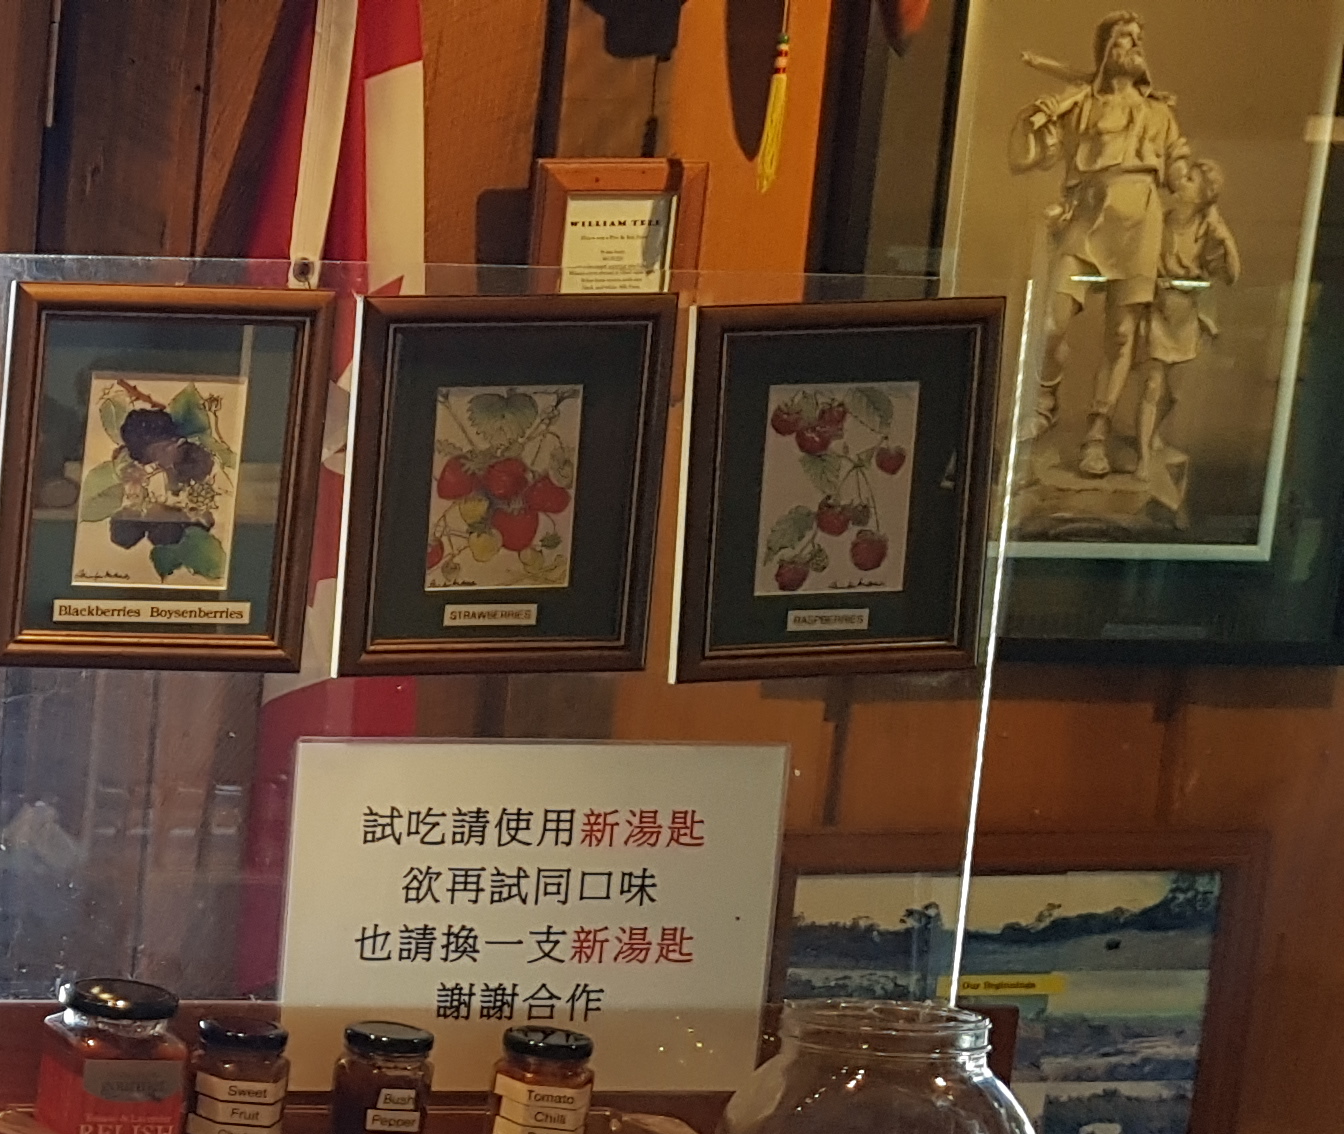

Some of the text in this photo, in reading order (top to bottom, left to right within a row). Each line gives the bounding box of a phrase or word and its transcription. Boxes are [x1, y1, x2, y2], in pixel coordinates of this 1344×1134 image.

[58, 605, 244, 620] Blackberries Boysenberries
[449, 609, 532, 621] STRAWBERRIES
[362, 805, 706, 849] 試吃請使用新湯匙
[401, 866, 658, 907] 欲再試同口味
[354, 924, 695, 965] 也請換一支新湯匙
[436, 983, 605, 1023] 謝謝合作
[228, 1086, 267, 1099] Sweet
[527, 1089, 575, 1105] Tomato
[231, 1108, 261, 1120] Fruit
[372, 1114, 416, 1128] Pepper
[534, 1111, 566, 1125] Chilli
